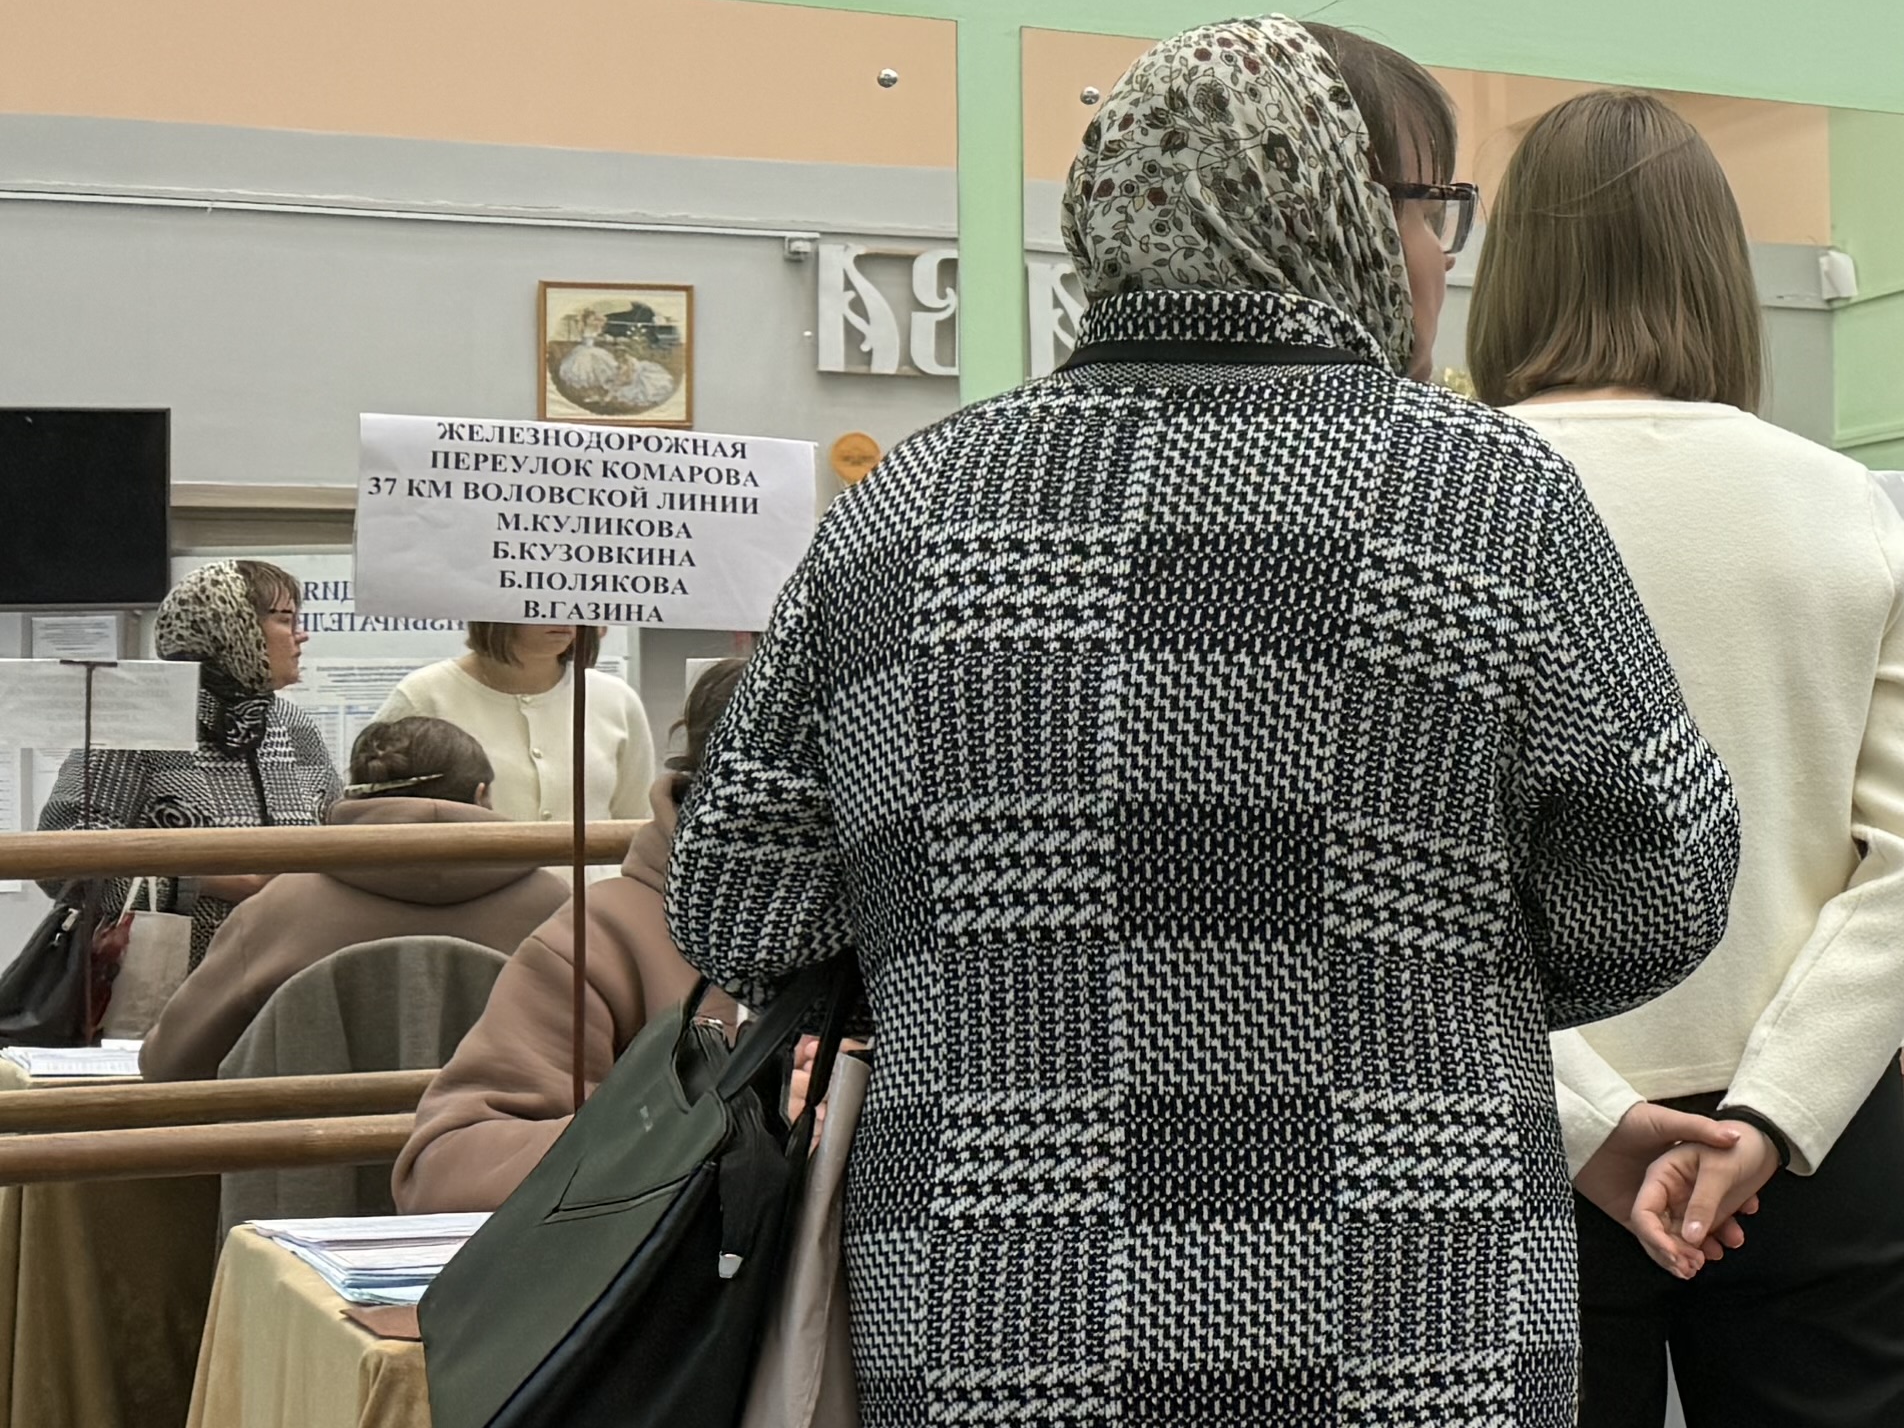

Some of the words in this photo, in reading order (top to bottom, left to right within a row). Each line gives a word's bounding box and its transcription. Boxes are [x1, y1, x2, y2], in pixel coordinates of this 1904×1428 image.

[437, 421, 748, 460] ЖЕЛЕЗНОДОРОЖНАЯ
[430, 449, 594, 479] ПЕРЕУЛОК
[601, 459, 761, 489] КОМАРОВА
[366, 476, 398, 498] 37
[406, 478, 454, 500] КМ
[463, 481, 650, 510] ВОЛОВСКОЙ
[656, 491, 760, 516] ЛИНИИ
[496, 511, 694, 540] М.КУЛИКОВА
[491, 540, 697, 568] Б.КУЗОВКИНА
[498, 570, 689, 597] Б.ПОЛЯКОВА
[522, 600, 665, 624] В.ГАЗИНА
